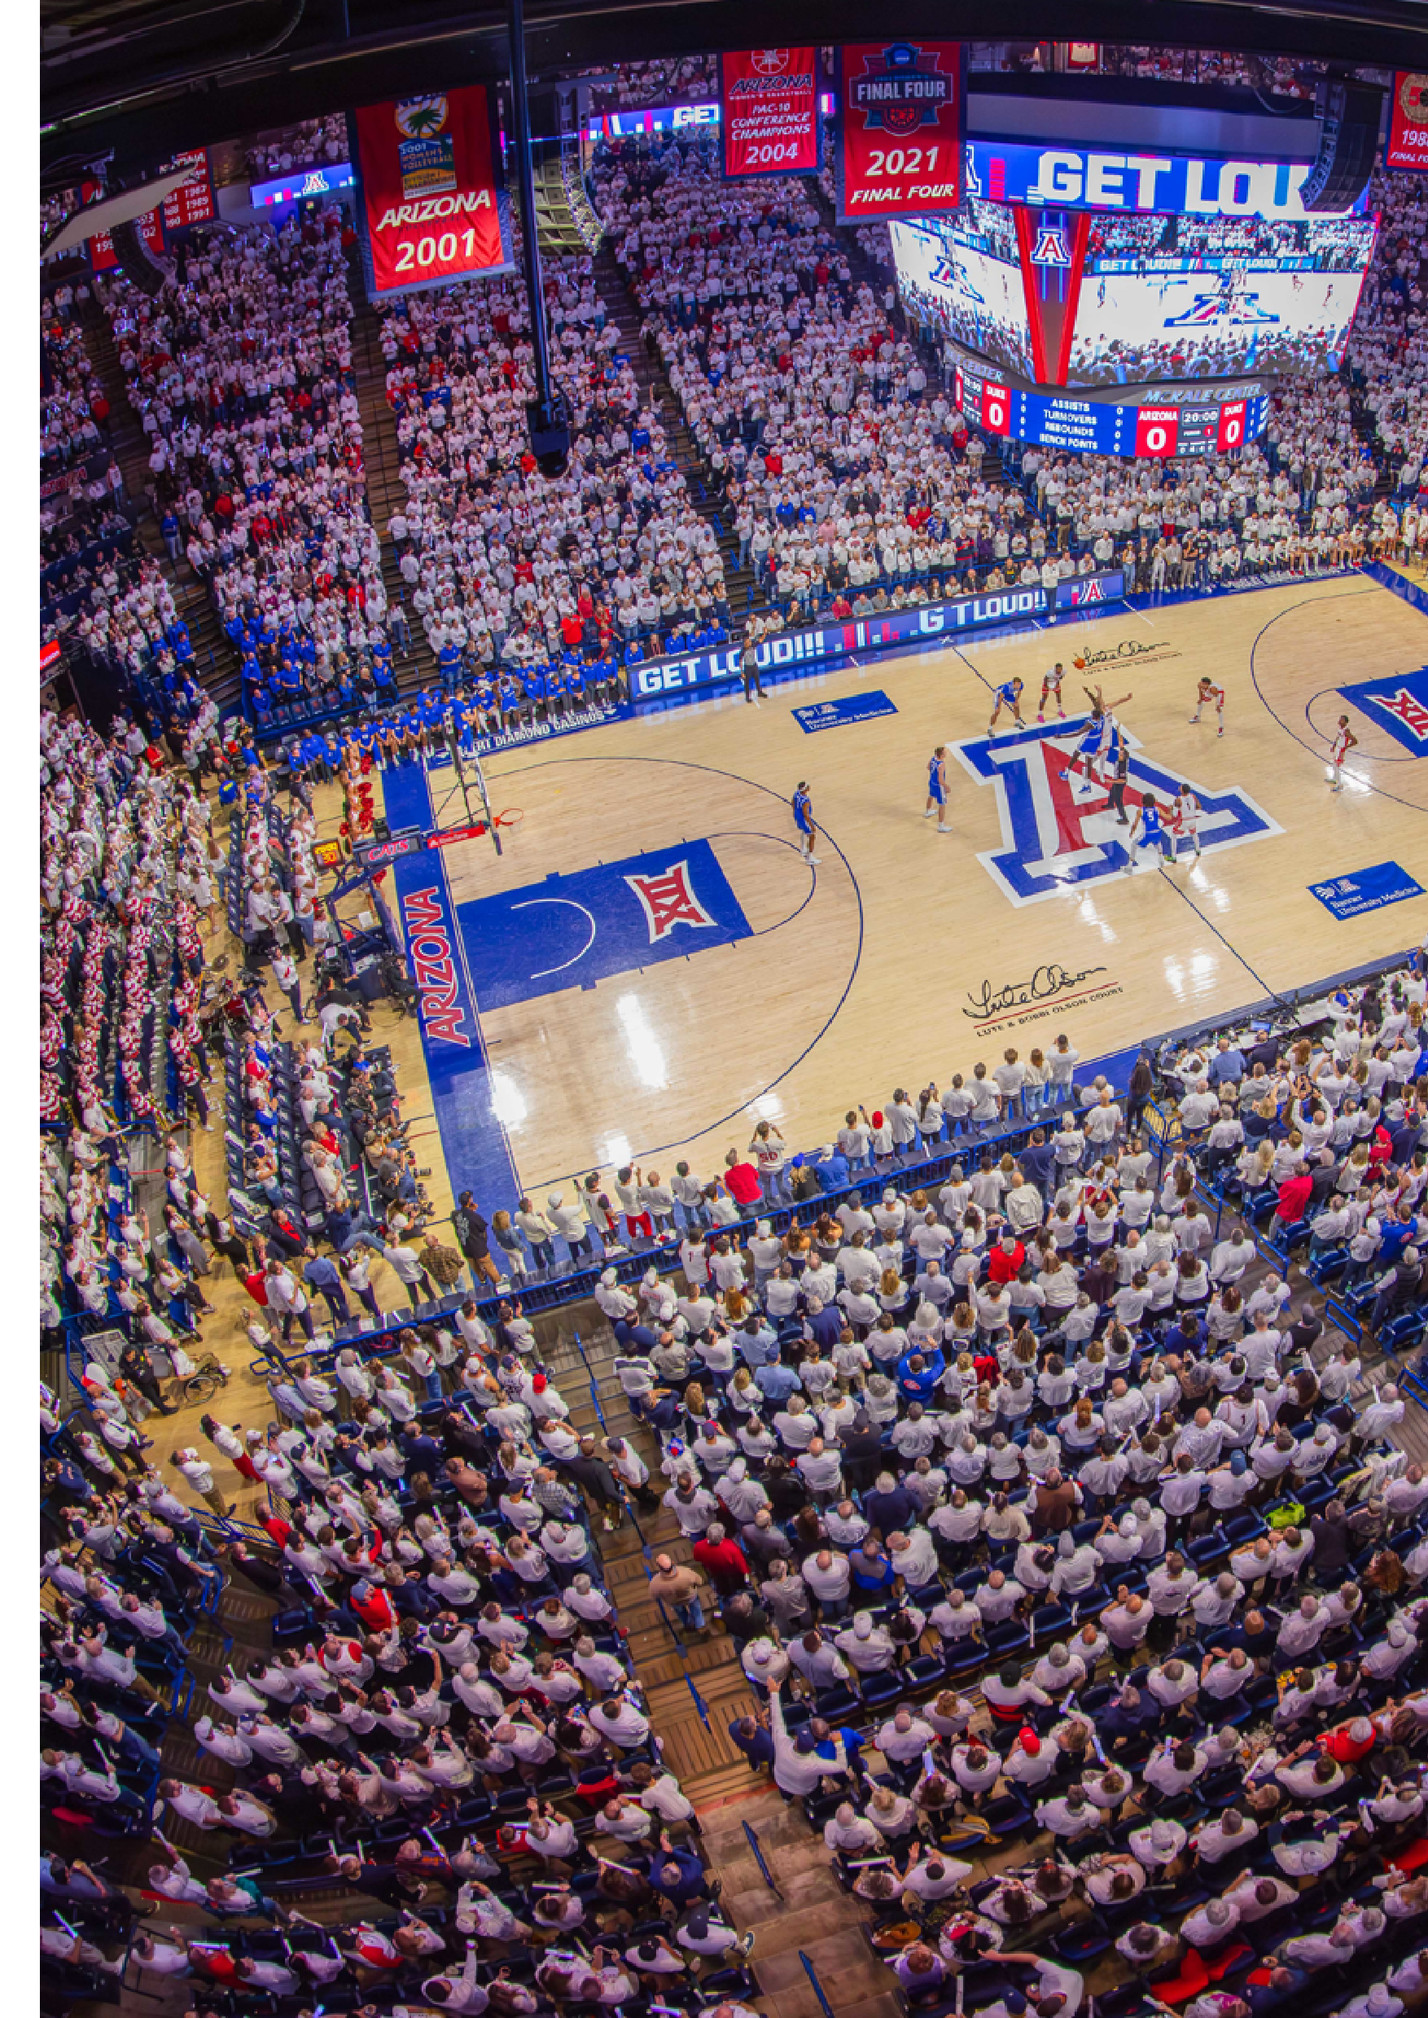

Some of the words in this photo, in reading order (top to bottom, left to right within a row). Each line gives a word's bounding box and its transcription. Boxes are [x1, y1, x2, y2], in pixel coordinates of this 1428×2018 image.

[730, 74, 813, 94] ARIZONA
[857, 83, 902, 101] FINAL
[904, 80, 946, 98] FOUR
[752, 102, 791, 114] PAC-10
[731, 111, 812, 129] CONFERENCE
[731, 123, 812, 141] CHAMPIONS
[1402, 129, 1428, 147] 198
[745, 142, 799, 165] 2004
[865, 146, 939, 177] 2021
[1391, 151, 1416, 162] FINAL
[850, 187, 903, 204] FINAL
[907, 184, 955, 199] FOUR
[1038, 150, 1172, 210] GET
[1185, 160, 1352, 221] LOU
[376, 189, 491, 231] ARIZONA
[395, 228, 475, 272] 2001
[1142, 389, 1214, 403] MCKALE
[1216, 383, 1261, 401] CENTER
[989, 403, 1003, 427] 0
[1051, 398, 1090, 412] ASSISTS
[1224, 402, 1244, 416] DUKE
[1043, 408, 1097, 424] TURNOVERS
[1138, 410, 1179, 421] ARIZONA
[1183, 411, 1218, 423] 20:00
[1045, 421, 1094, 436] REBOUNDS
[1146, 427, 1167, 450] 0
[1227, 420, 1240, 443] 0
[1039, 433, 1066, 446] BENCH
[1068, 438, 1098, 450] POINTS
[638, 656, 702, 694] GET
[495, 723, 550, 748] DIAMOND
[554, 711, 605, 731] CASINOS
[369, 838, 410, 862] CATS
[403, 886, 471, 1048] ARIZONA
[1031, 964, 1107, 1000] Olson
[976, 1022, 1004, 1038] LUTE
[1018, 1010, 1051, 1026] BOBBI
[1052, 998, 1089, 1014] OLSON
[1089, 986, 1124, 1003] COURT
